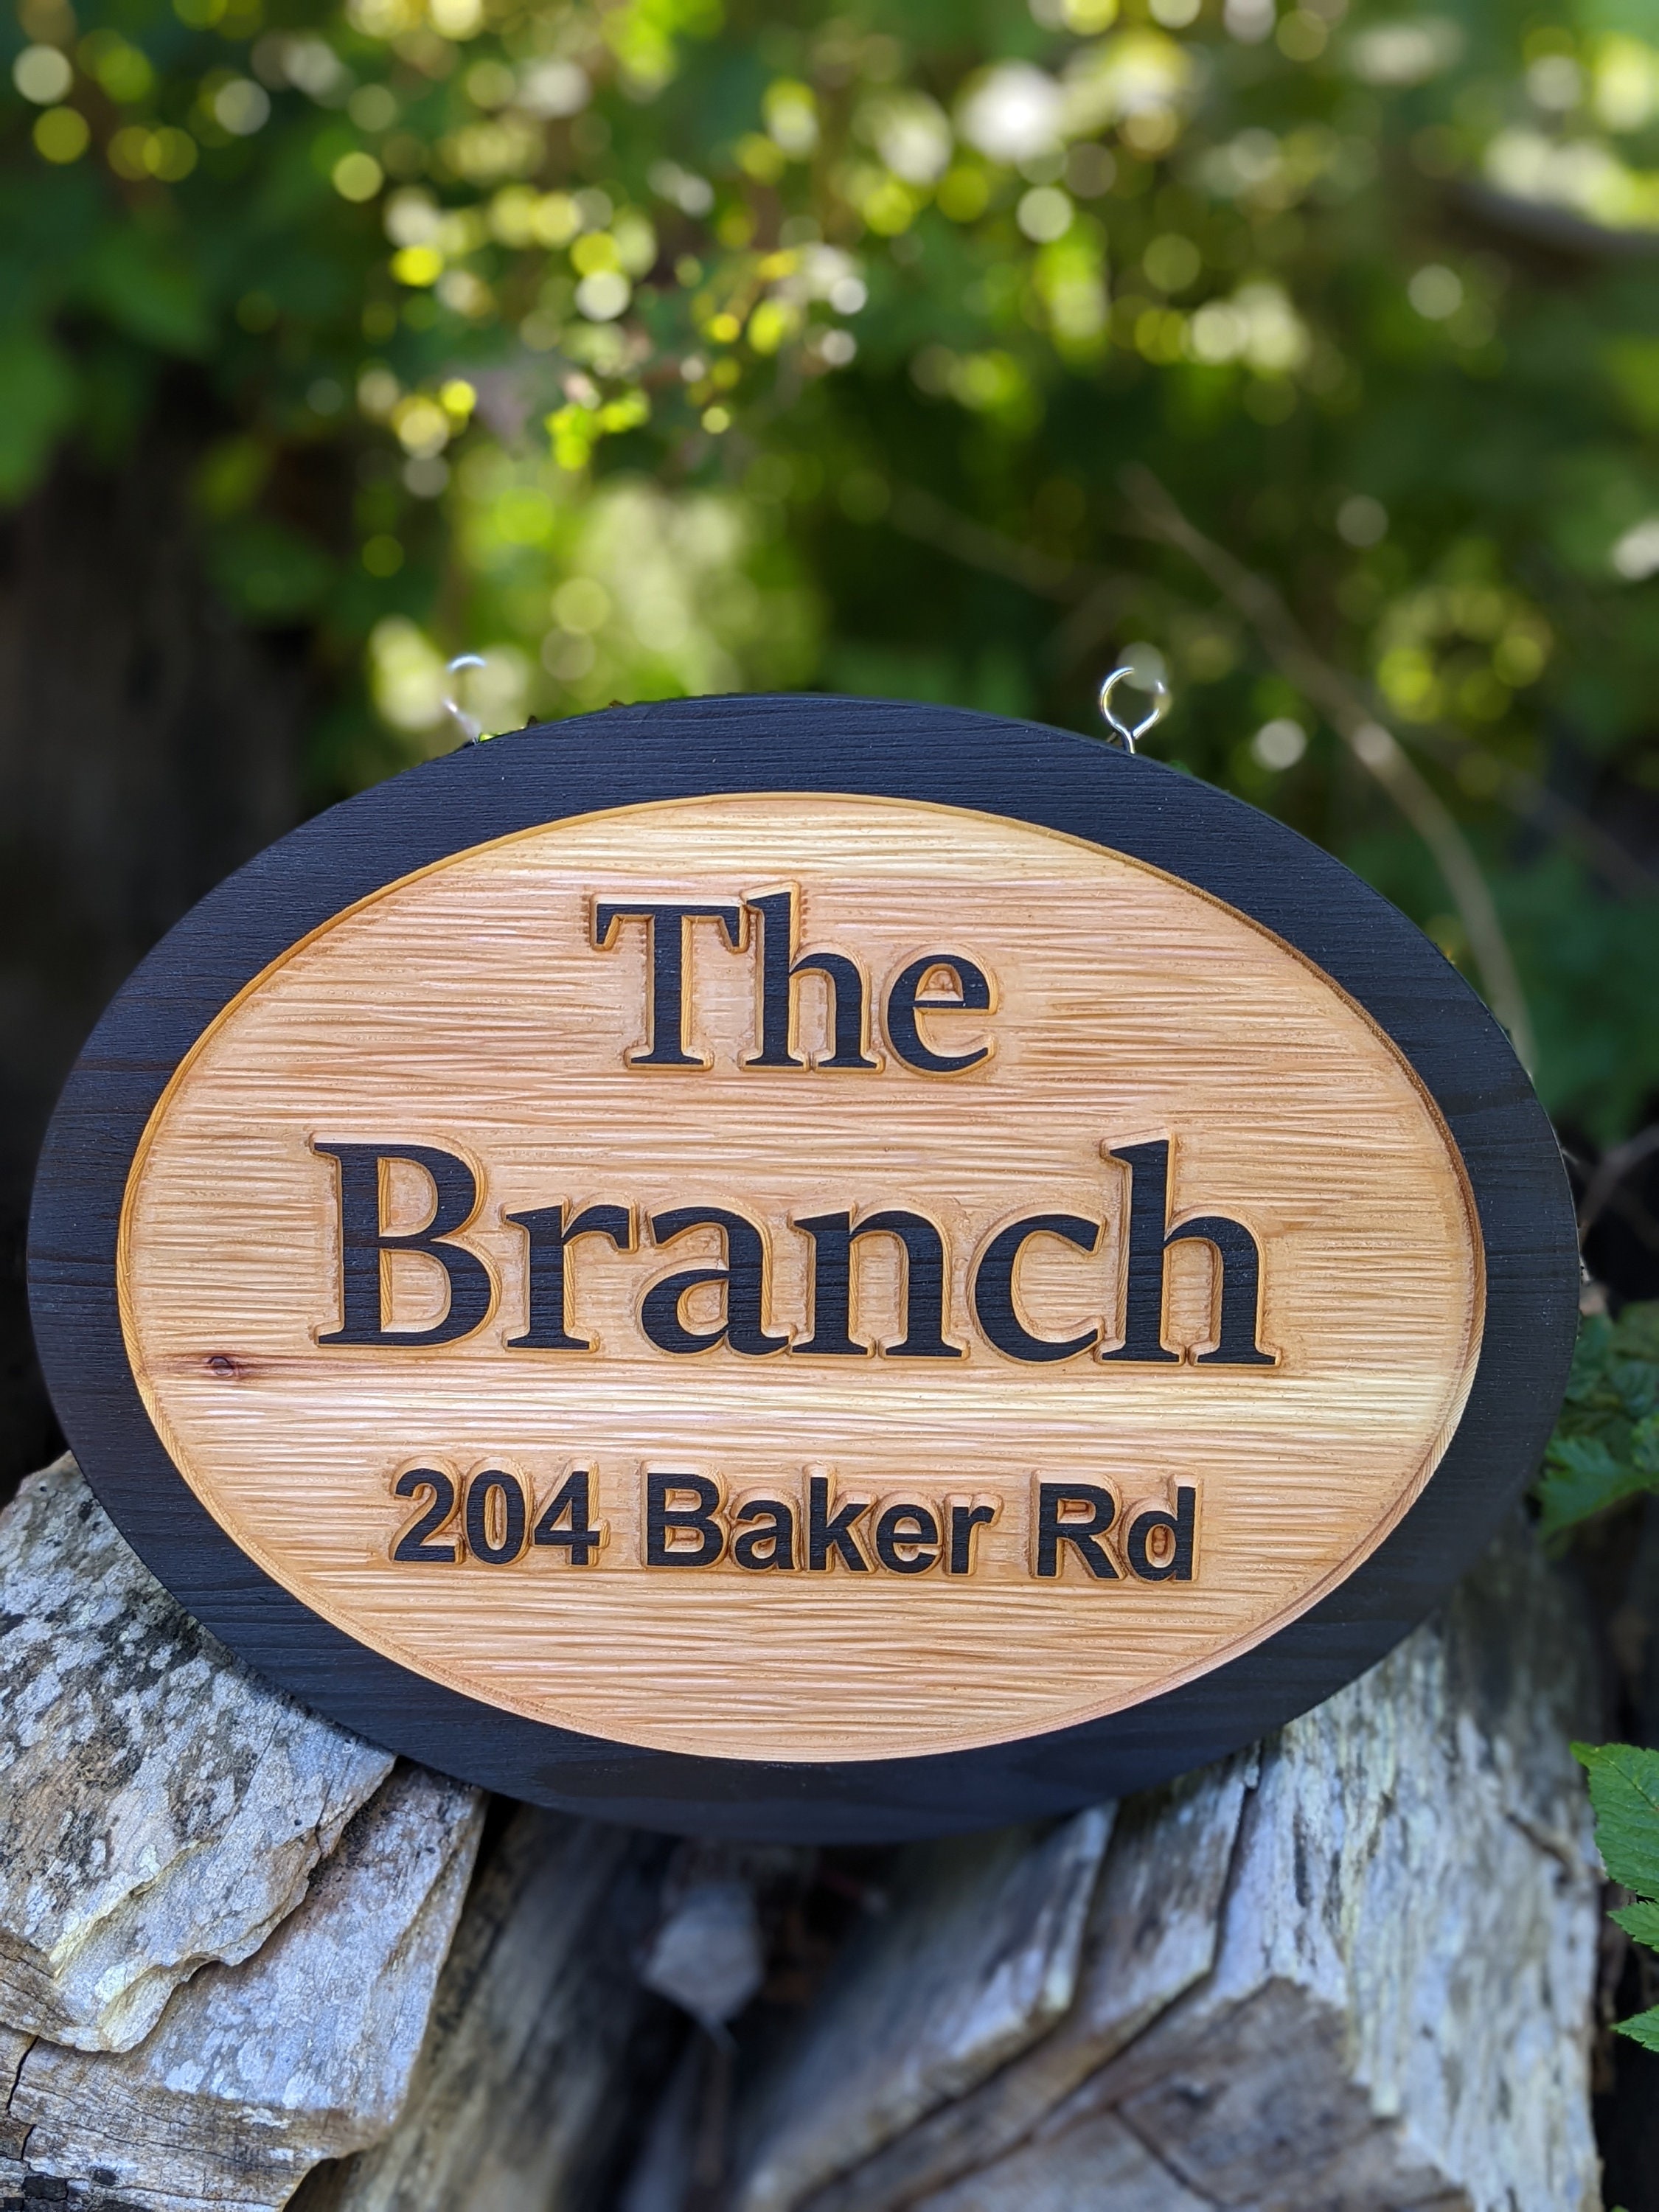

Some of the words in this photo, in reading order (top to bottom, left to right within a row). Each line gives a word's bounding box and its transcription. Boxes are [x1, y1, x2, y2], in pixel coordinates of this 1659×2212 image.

[595, 891, 991, 1072] The
[313, 1139, 1276, 1364] Branch
[394, 1468, 601, 1565] 204
[647, 1472, 995, 1574] Baker
[1037, 1483, 1196, 1582] Rd
